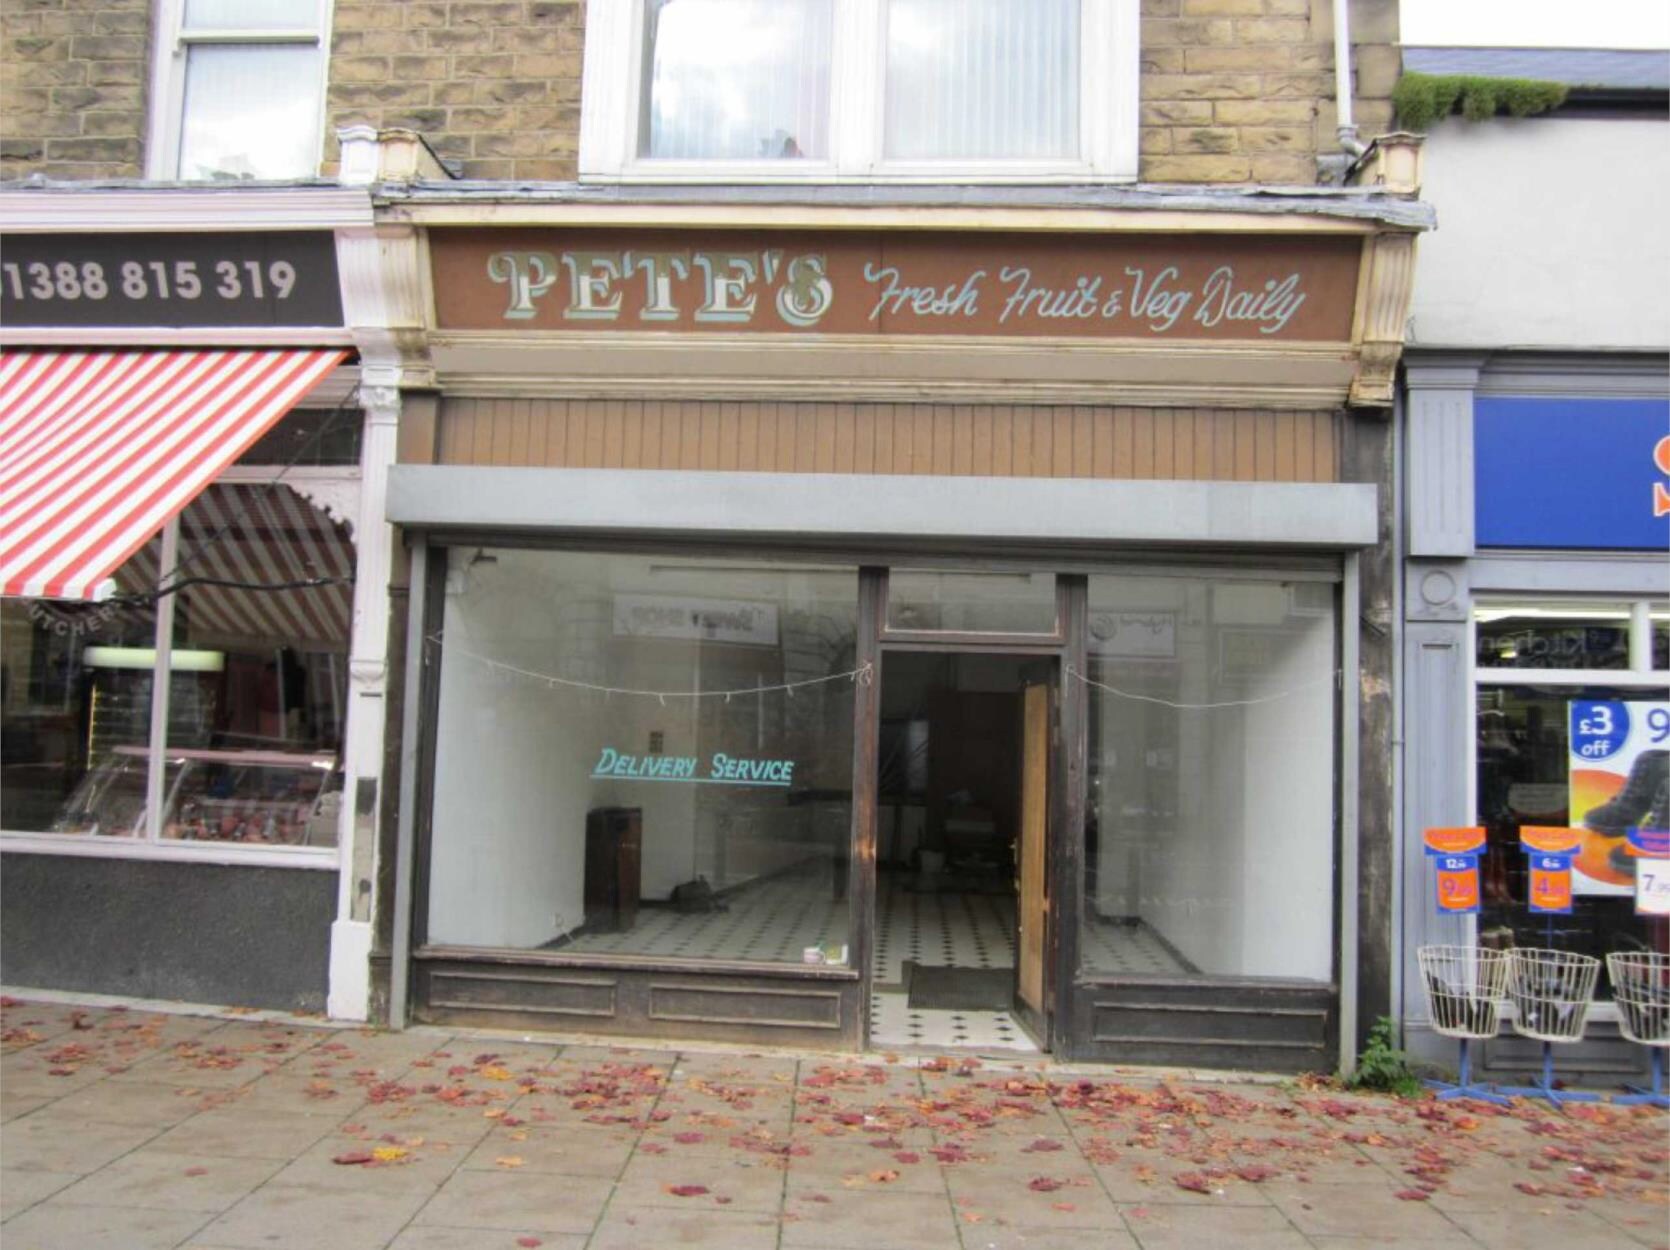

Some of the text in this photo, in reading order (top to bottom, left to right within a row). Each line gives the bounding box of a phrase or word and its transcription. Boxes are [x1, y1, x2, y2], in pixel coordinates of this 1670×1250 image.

[0, 260, 297, 300] 1388 815 319
[487, 249, 834, 327] PETE'S
[863, 262, 1307, 334] Fresh Fruit & Veg Daily
[1579, 704, 1614, 736] £3
[594, 747, 795, 782] DELIVERY SERVICE
[1580, 739, 1611, 756] off
